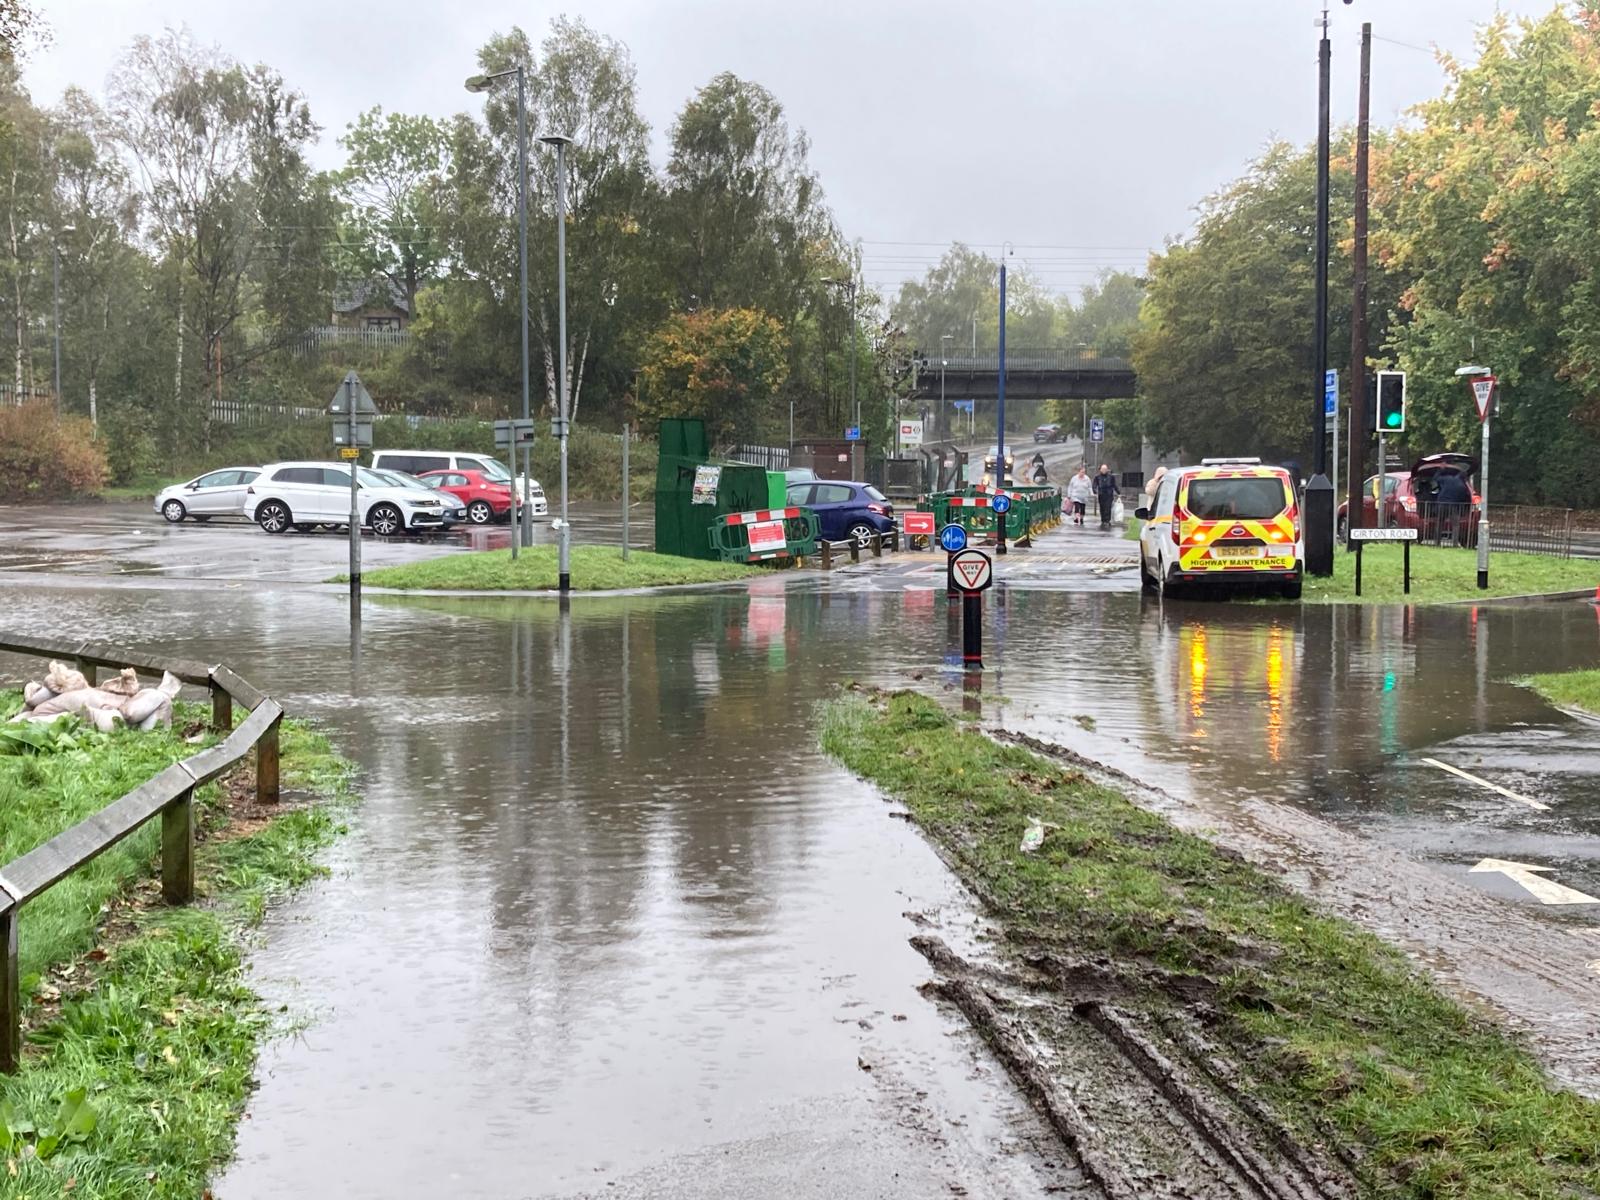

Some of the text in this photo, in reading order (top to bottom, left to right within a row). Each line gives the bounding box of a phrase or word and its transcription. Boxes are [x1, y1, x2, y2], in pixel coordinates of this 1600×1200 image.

[1475, 383, 1490, 392] GIVE
[1353, 530, 1415, 538] GIRTON ROAD
[1229, 558, 1286, 566] MAINTENANCE
